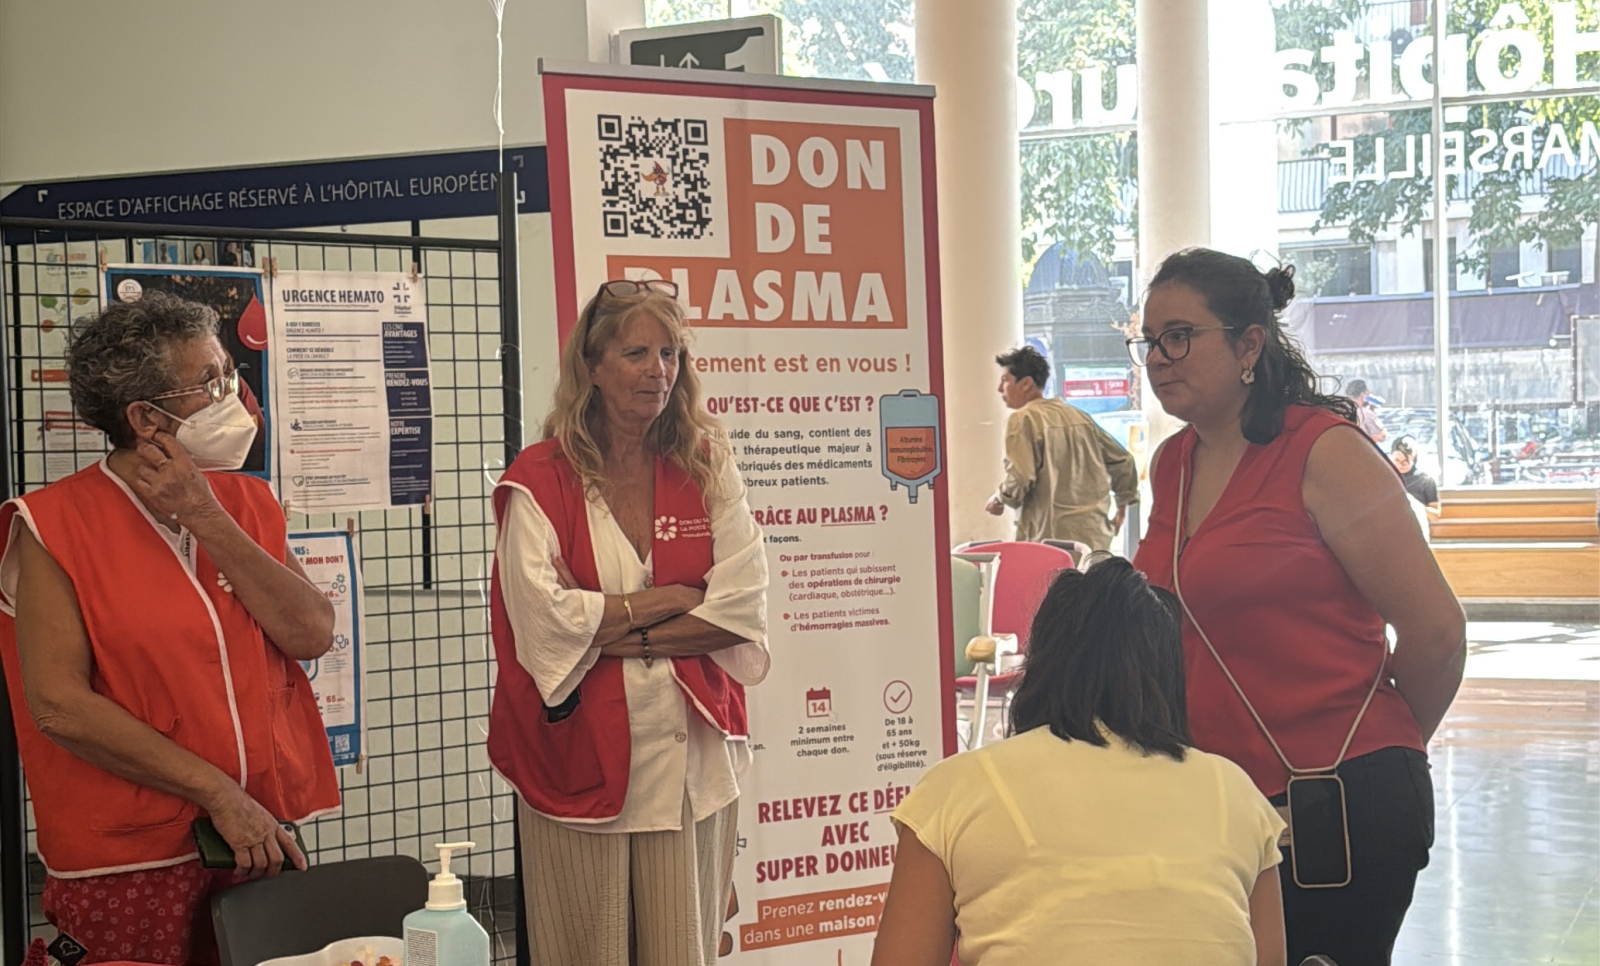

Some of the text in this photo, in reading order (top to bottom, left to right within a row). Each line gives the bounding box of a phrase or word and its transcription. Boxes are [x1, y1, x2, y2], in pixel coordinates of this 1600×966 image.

[750, 134, 886, 190] DON
[58, 200, 114, 220] ESPACE
[119, 191, 223, 216] D'AFFICHAGE
[228, 184, 298, 208] RÉSERVÉ
[303, 183, 315, 203] À
[320, 180, 404, 202] L'HÔPITAL
[755, 202, 832, 254] DE
[282, 290, 384, 303] URGENCE HEMATO
[384, 330, 418, 338] AVANTAGES
[774, 354, 808, 373] est
[816, 356, 841, 373] en
[847, 356, 898, 373] vous
[905, 354, 911, 372] !
[386, 378, 428, 386] RENDEZ-VOUS
[707, 395, 874, 414] QU'EST-CE QUE C'EST ?
[391, 427, 421, 435] EXPERTISE
[755, 429, 769, 439] du
[774, 430, 803, 441] sang,
[809, 428, 850, 438] contient
[854, 428, 871, 438] des
[744, 445, 821, 456] thérapeutique
[827, 444, 860, 455] majeur
[866, 443, 872, 452] à
[785, 460, 804, 470] des
[807, 459, 872, 470] médicaments
[781, 476, 829, 487] patients.
[796, 508, 817, 525] AU
[821, 505, 876, 523] PLASMA
[879, 504, 888, 521] ?
[769, 535, 802, 544] façons.
[306, 557, 323, 565] MON
[780, 554, 792, 562] Ou
[794, 554, 808, 563] par
[810, 552, 853, 561] transfusion
[855, 552, 870, 561] pour
[792, 565, 896, 578] Les patients qui subissent
[789, 575, 901, 590] des opérations de chirurgie
[789, 591, 839, 602] (cardiaque,
[794, 607, 880, 620] Les patients victimes
[791, 618, 890, 632] d'hémorragies massives.
[811, 702, 826, 713] 14
[885, 716, 913, 726] De 18 à
[799, 724, 846, 734] 2 semaines
[886, 729, 896, 737] 65
[790, 734, 854, 746] minimum entre
[899, 739, 920, 750] 50kg
[797, 746, 849, 758] chaque don.
[876, 749, 927, 762] (sous réserve
[877, 760, 926, 772] d'éligibilité).
[758, 794, 841, 824] RELEVEZ
[848, 792, 868, 814] CE
[821, 821, 869, 847] AVEC
[756, 855, 819, 883] SUPER
[762, 891, 887, 920] Prenez rendez-v
[744, 914, 875, 944] dans une maison
